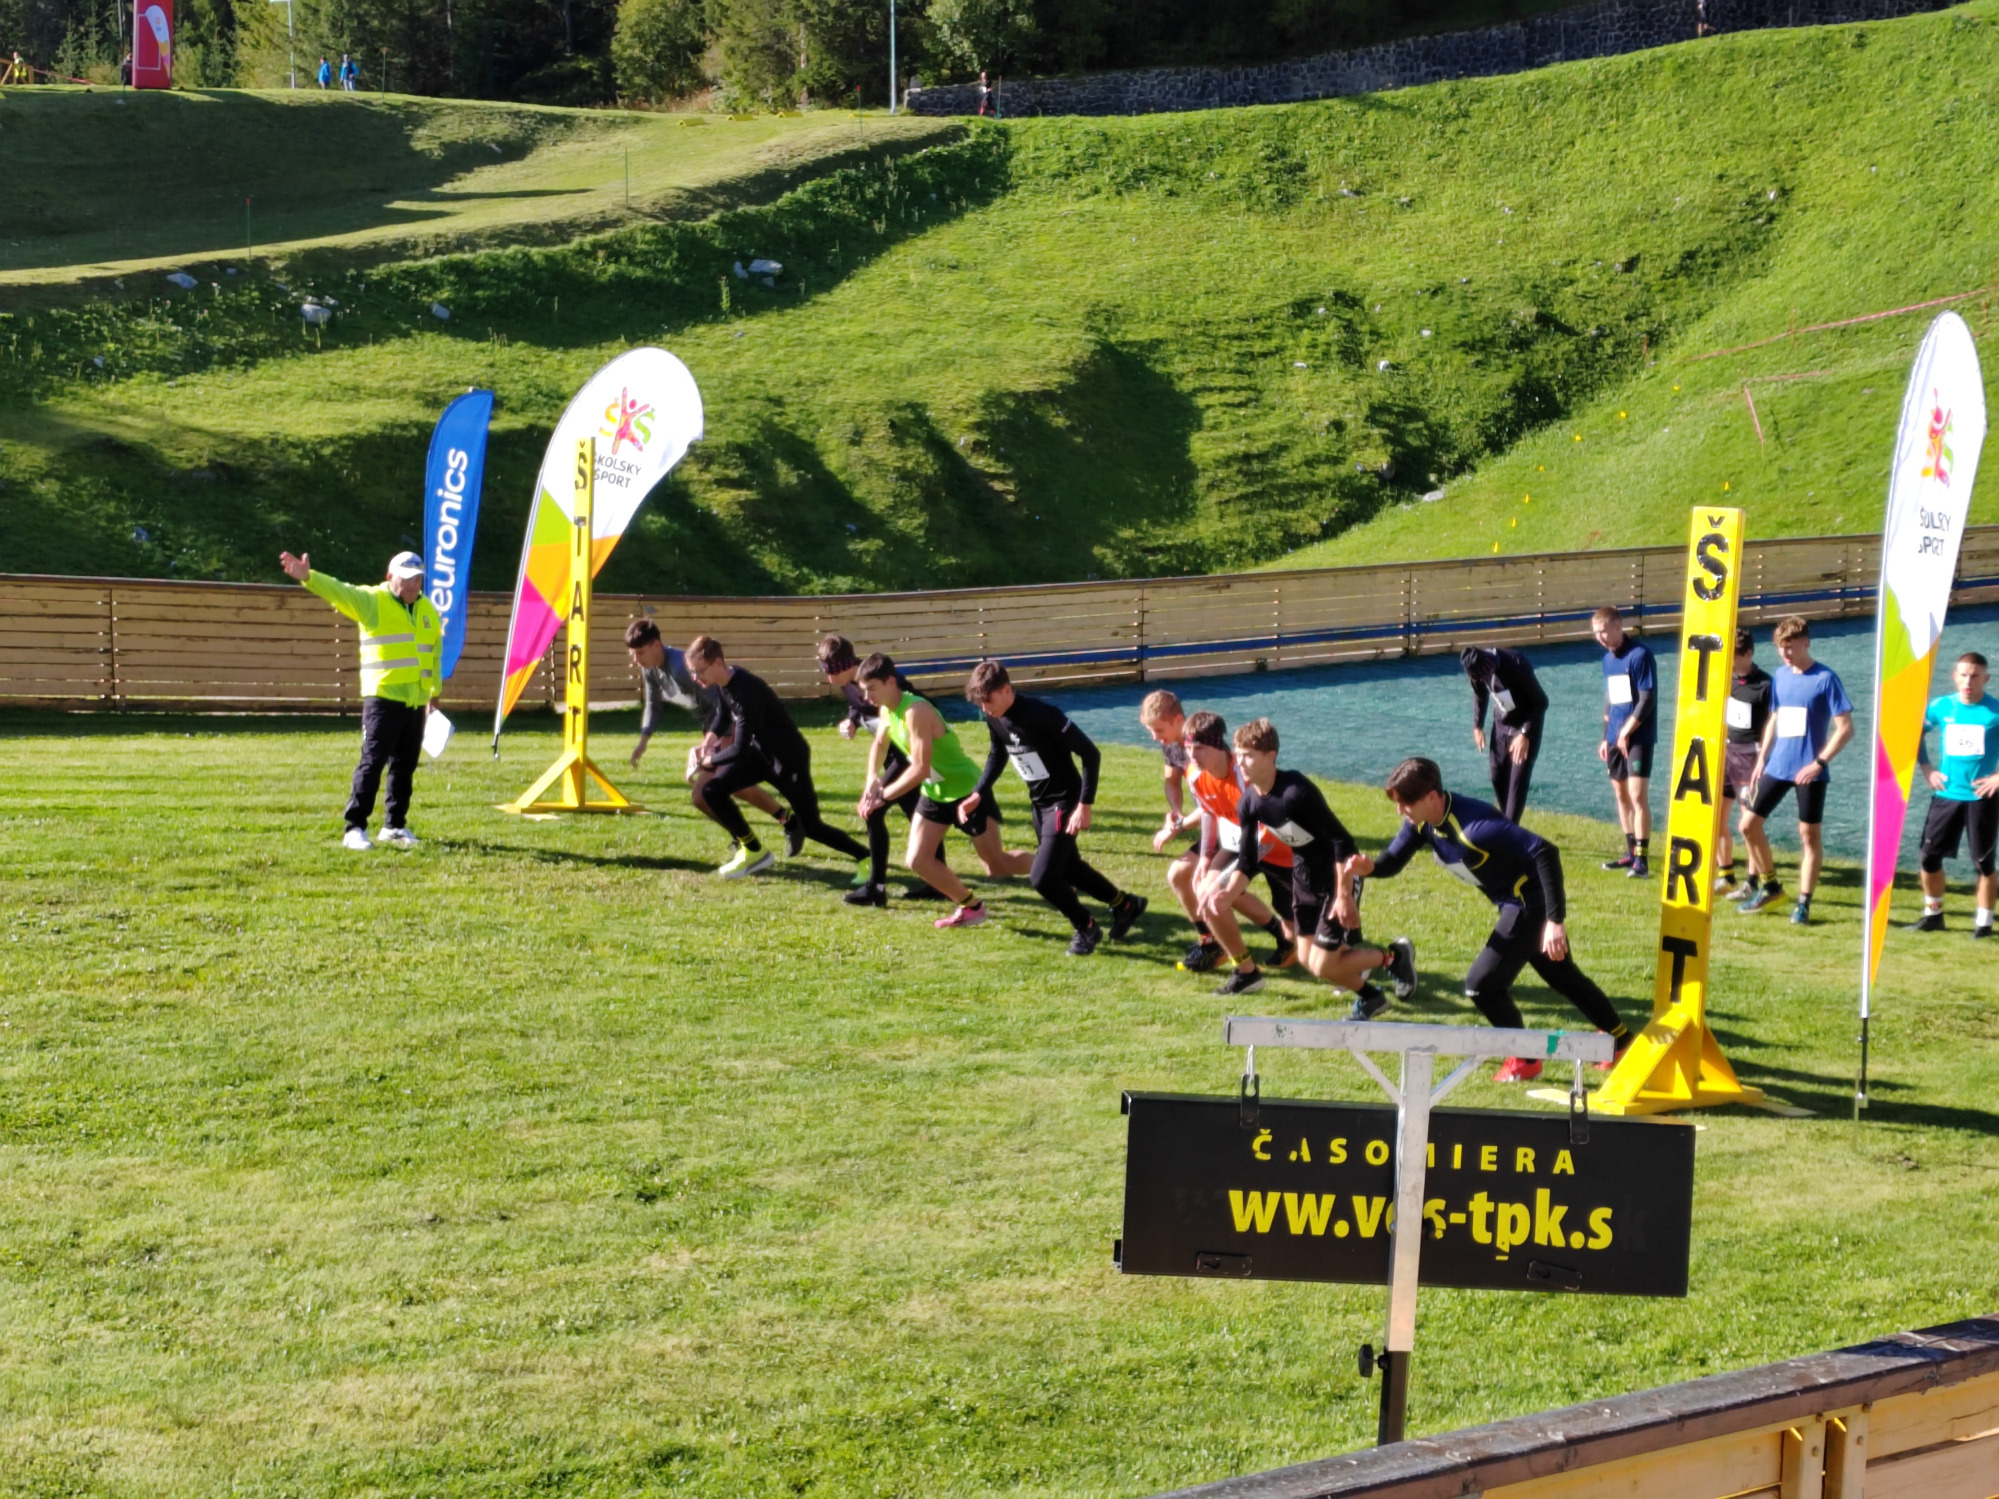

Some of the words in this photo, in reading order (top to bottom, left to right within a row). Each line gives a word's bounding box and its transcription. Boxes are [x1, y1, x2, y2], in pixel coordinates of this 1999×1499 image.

[430, 448, 468, 613] euronics
[568, 441, 588, 745] ŠTART
[1662, 514, 1729, 1004] ŠTART
